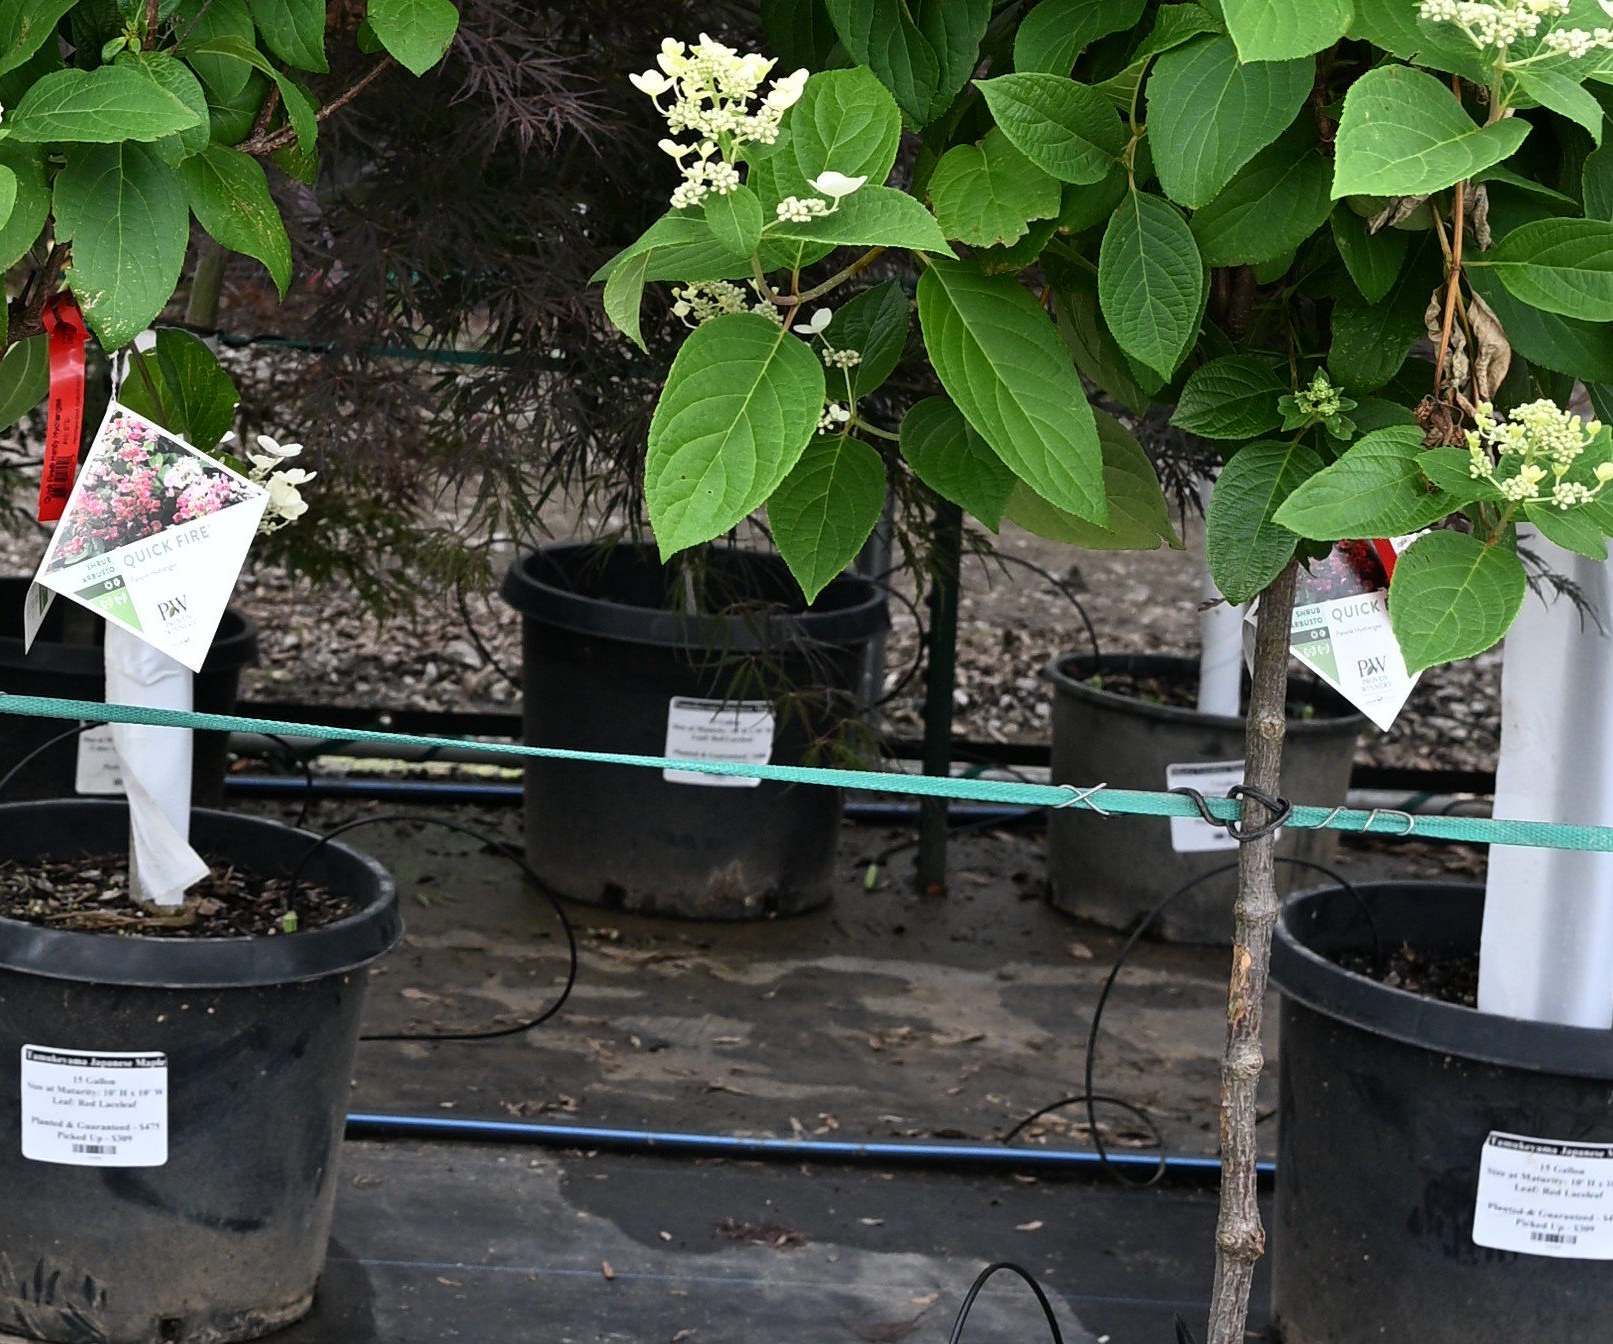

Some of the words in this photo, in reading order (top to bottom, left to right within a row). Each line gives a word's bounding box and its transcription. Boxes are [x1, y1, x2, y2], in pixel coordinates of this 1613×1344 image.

[123, 539, 172, 568] QUICK
[1295, 606, 1321, 617] SHRUB
[1331, 599, 1381, 621] QUICK
